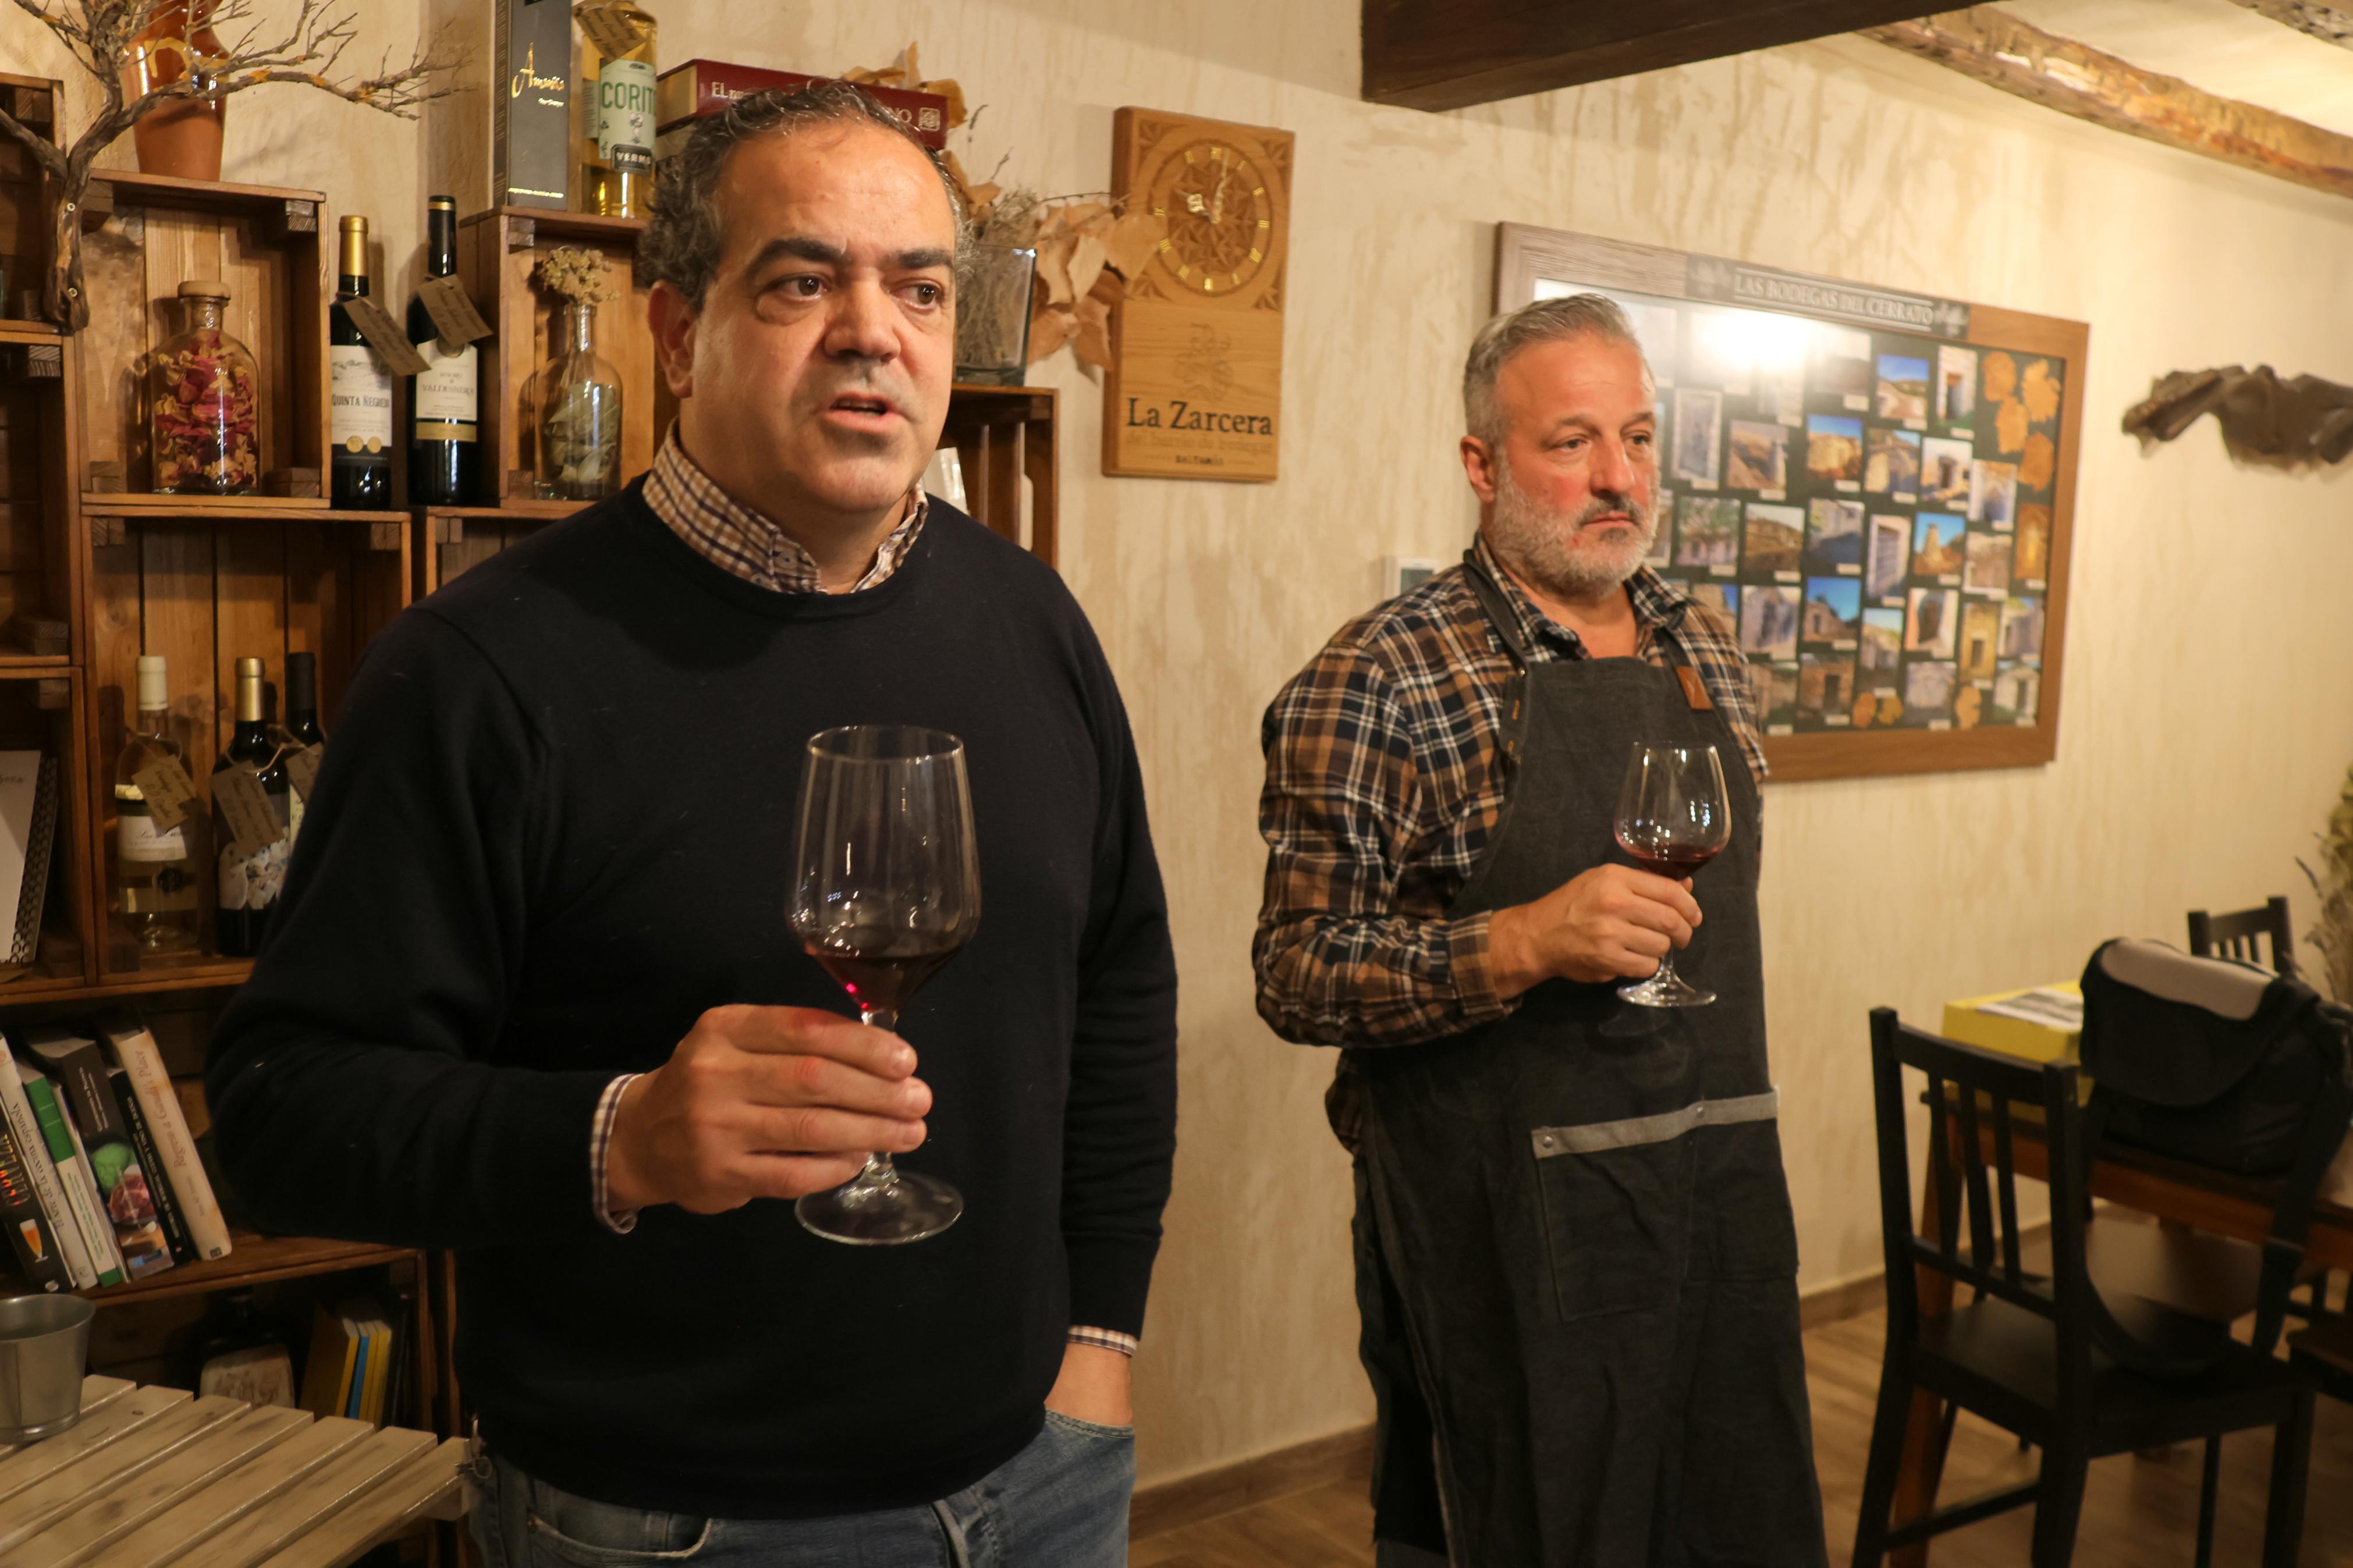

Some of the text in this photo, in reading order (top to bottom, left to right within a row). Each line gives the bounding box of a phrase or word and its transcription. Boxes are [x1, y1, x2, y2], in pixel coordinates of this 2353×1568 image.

[712, 81, 728, 98] EL
[1734, 273, 1765, 296] LAS
[1766, 279, 1839, 308] BODEGAS
[1866, 297, 1934, 326] CERRATO
[331, 393, 360, 406] QUINTA
[1127, 397, 1274, 435] La Zarcera
[10, 1102, 33, 1143] española
[29, 1144, 44, 1174] cocina
